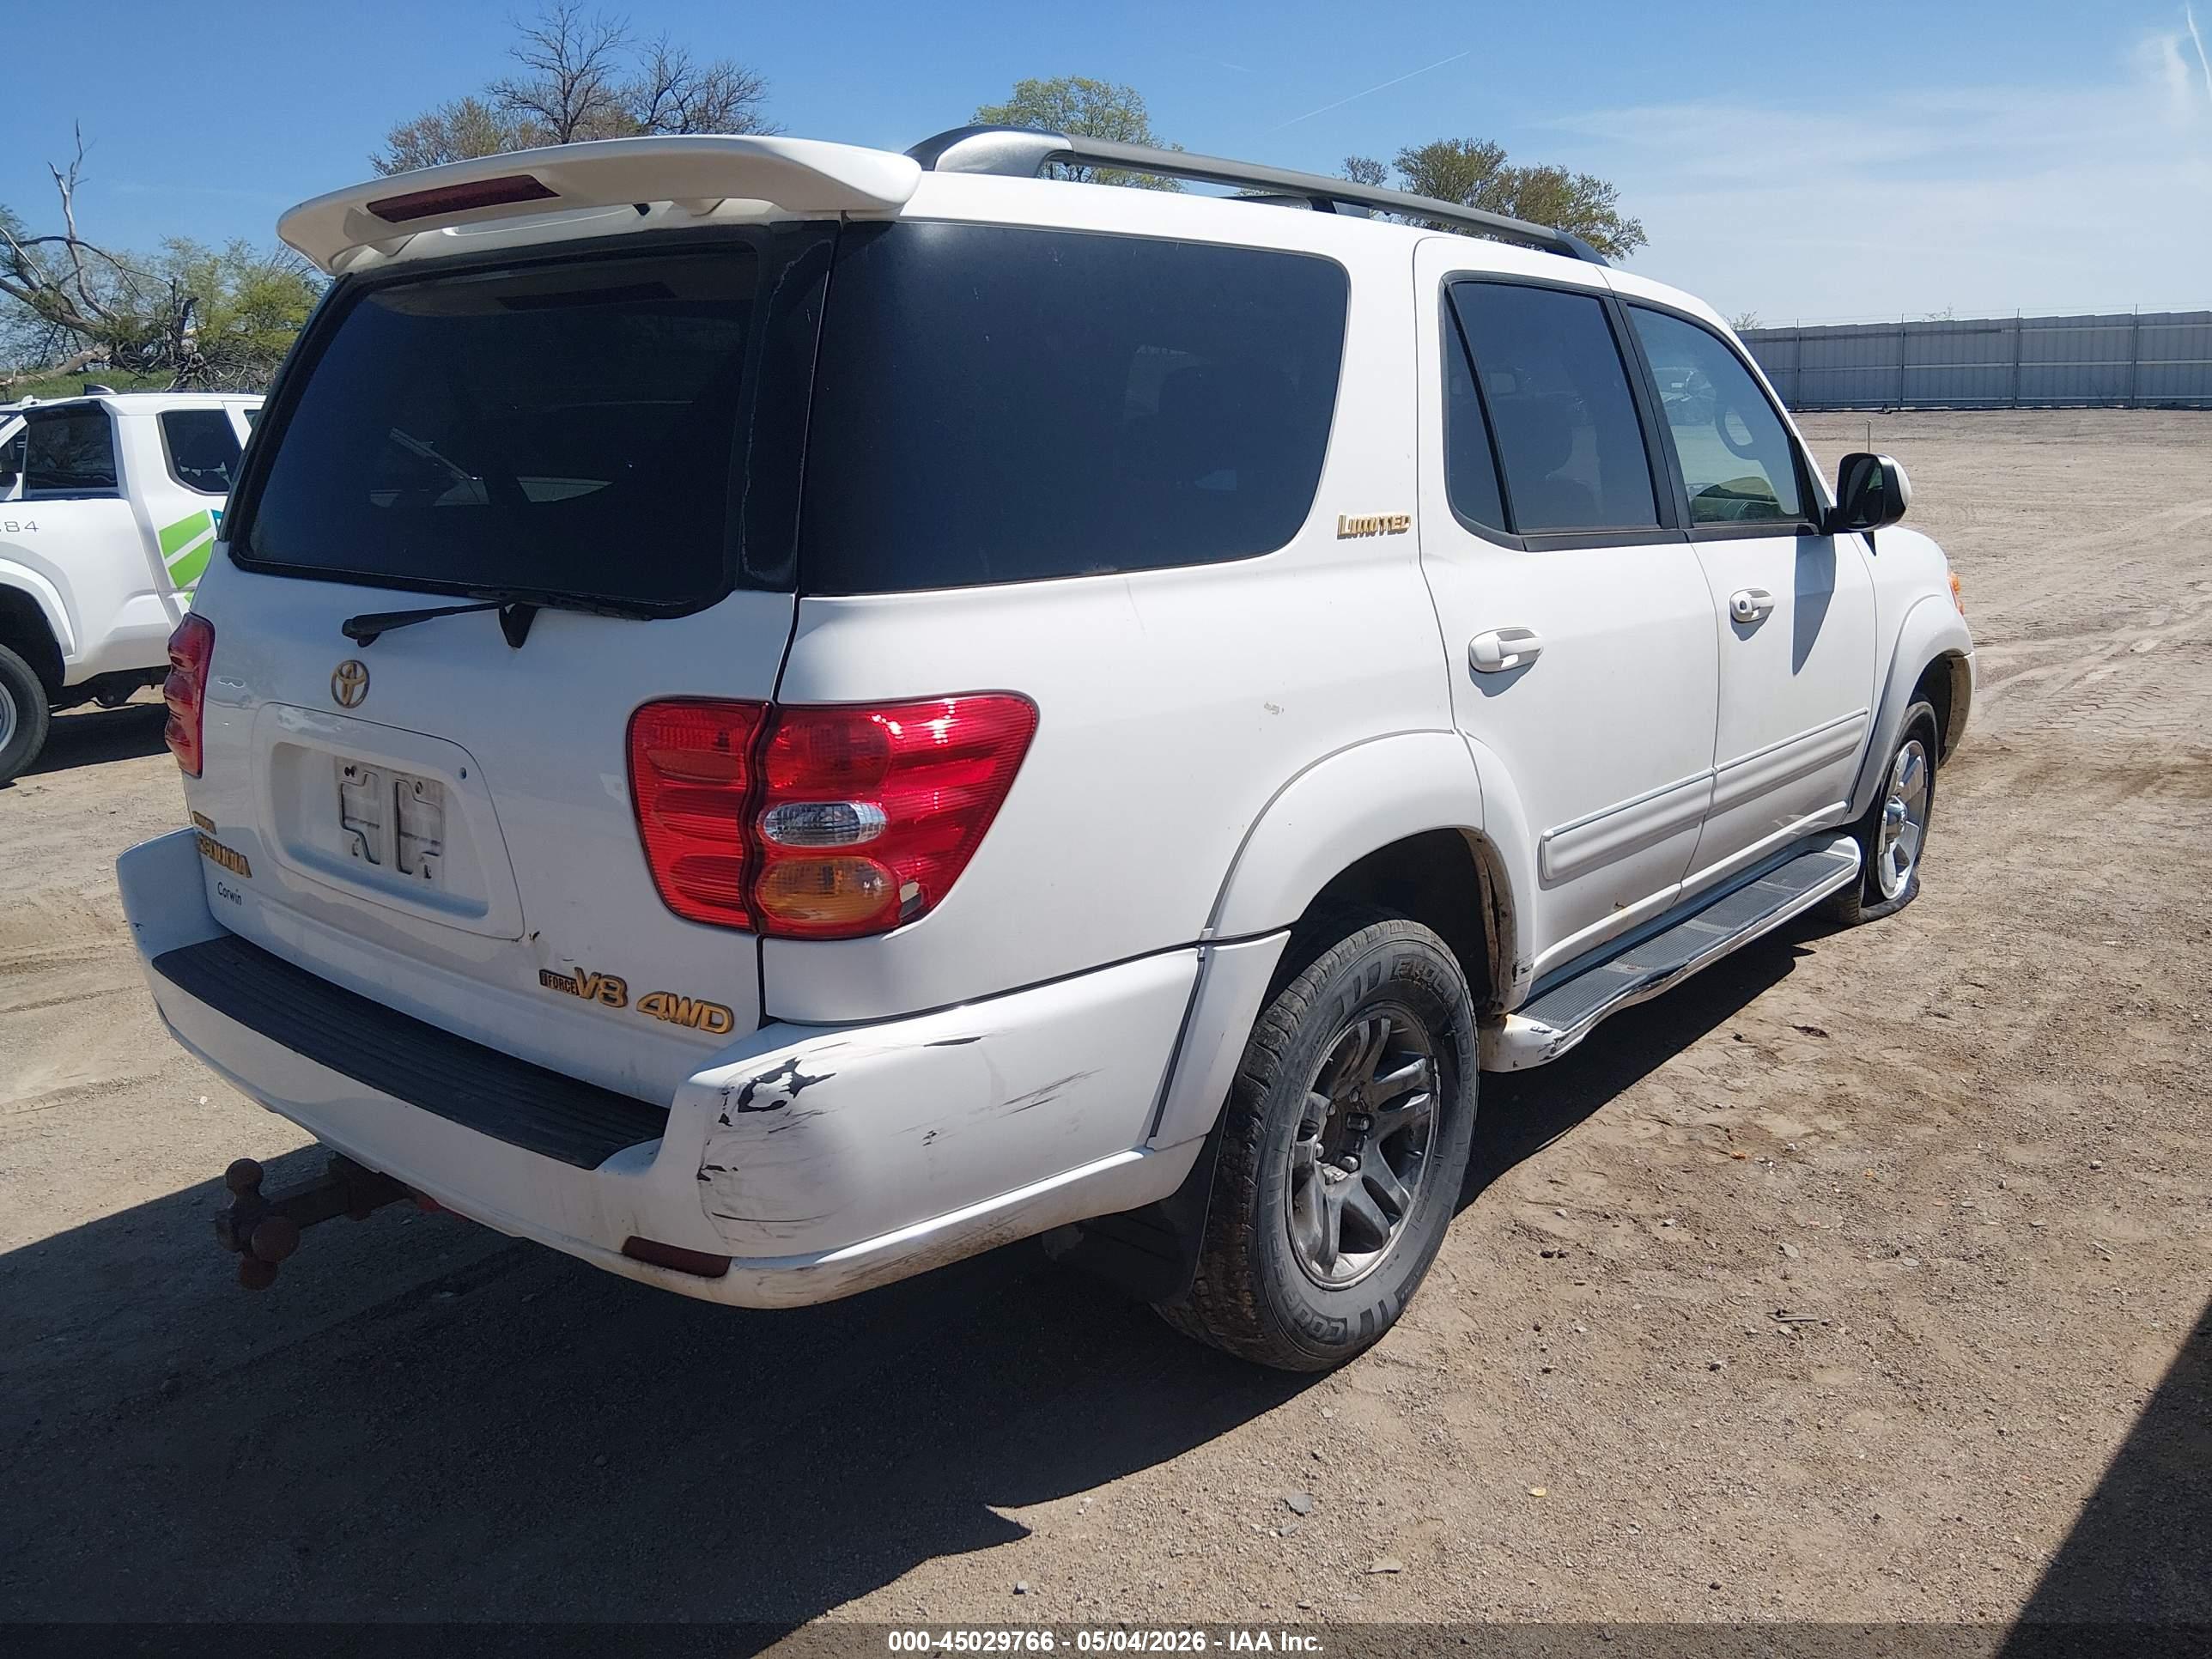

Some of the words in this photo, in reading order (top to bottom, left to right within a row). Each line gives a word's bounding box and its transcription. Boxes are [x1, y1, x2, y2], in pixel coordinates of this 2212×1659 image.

[0, 520, 40, 532] 84
[217, 881, 242, 906] Corwin
[574, 967, 628, 1008] V8
[636, 990, 734, 1034] 4WD
